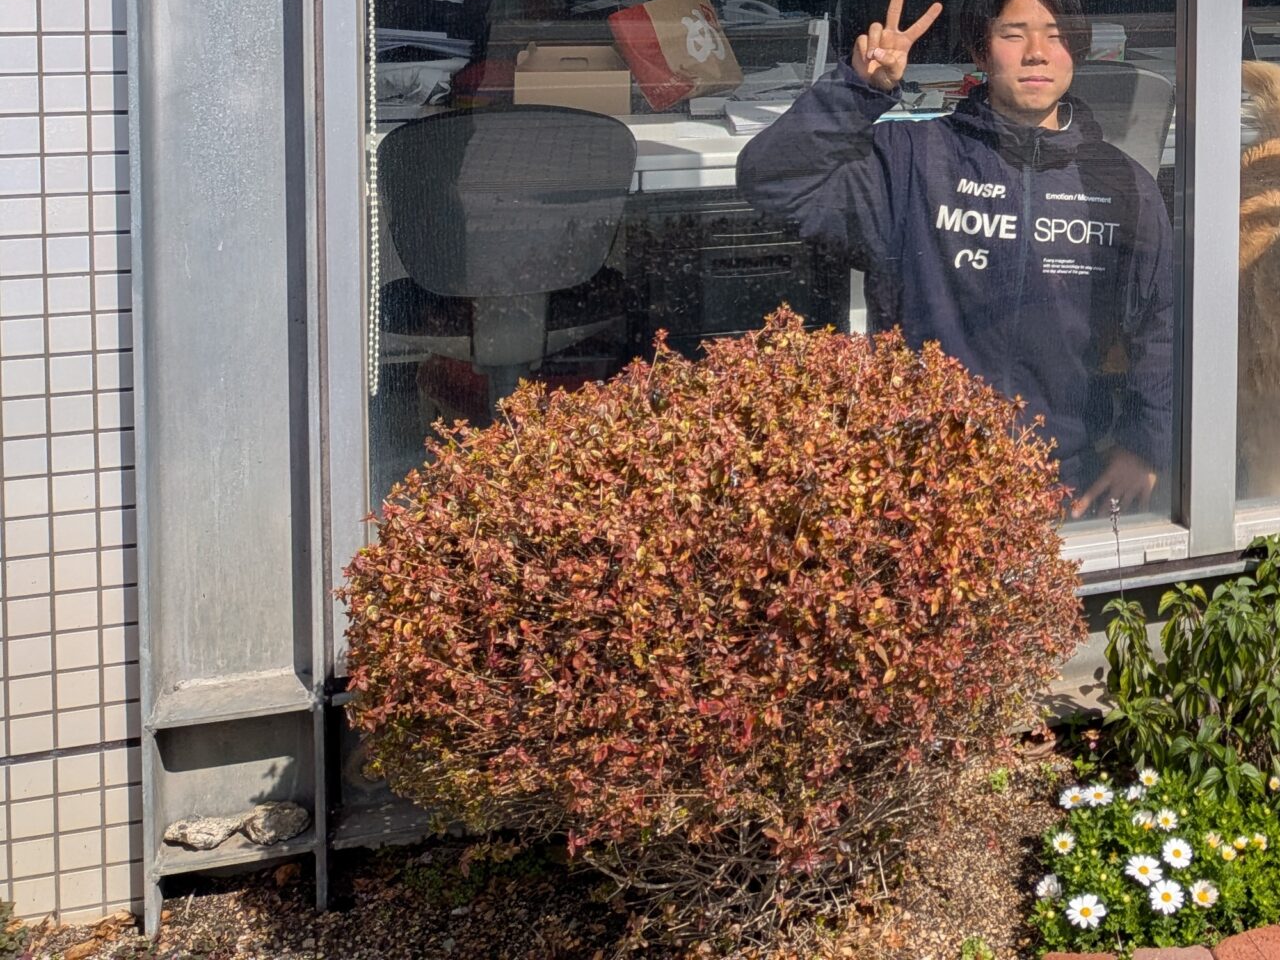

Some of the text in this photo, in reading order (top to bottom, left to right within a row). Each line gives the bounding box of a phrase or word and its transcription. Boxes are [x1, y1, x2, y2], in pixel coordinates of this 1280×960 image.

[957, 178, 1007, 199] MVSP.
[935, 204, 1121, 247] MOVE SPORT
